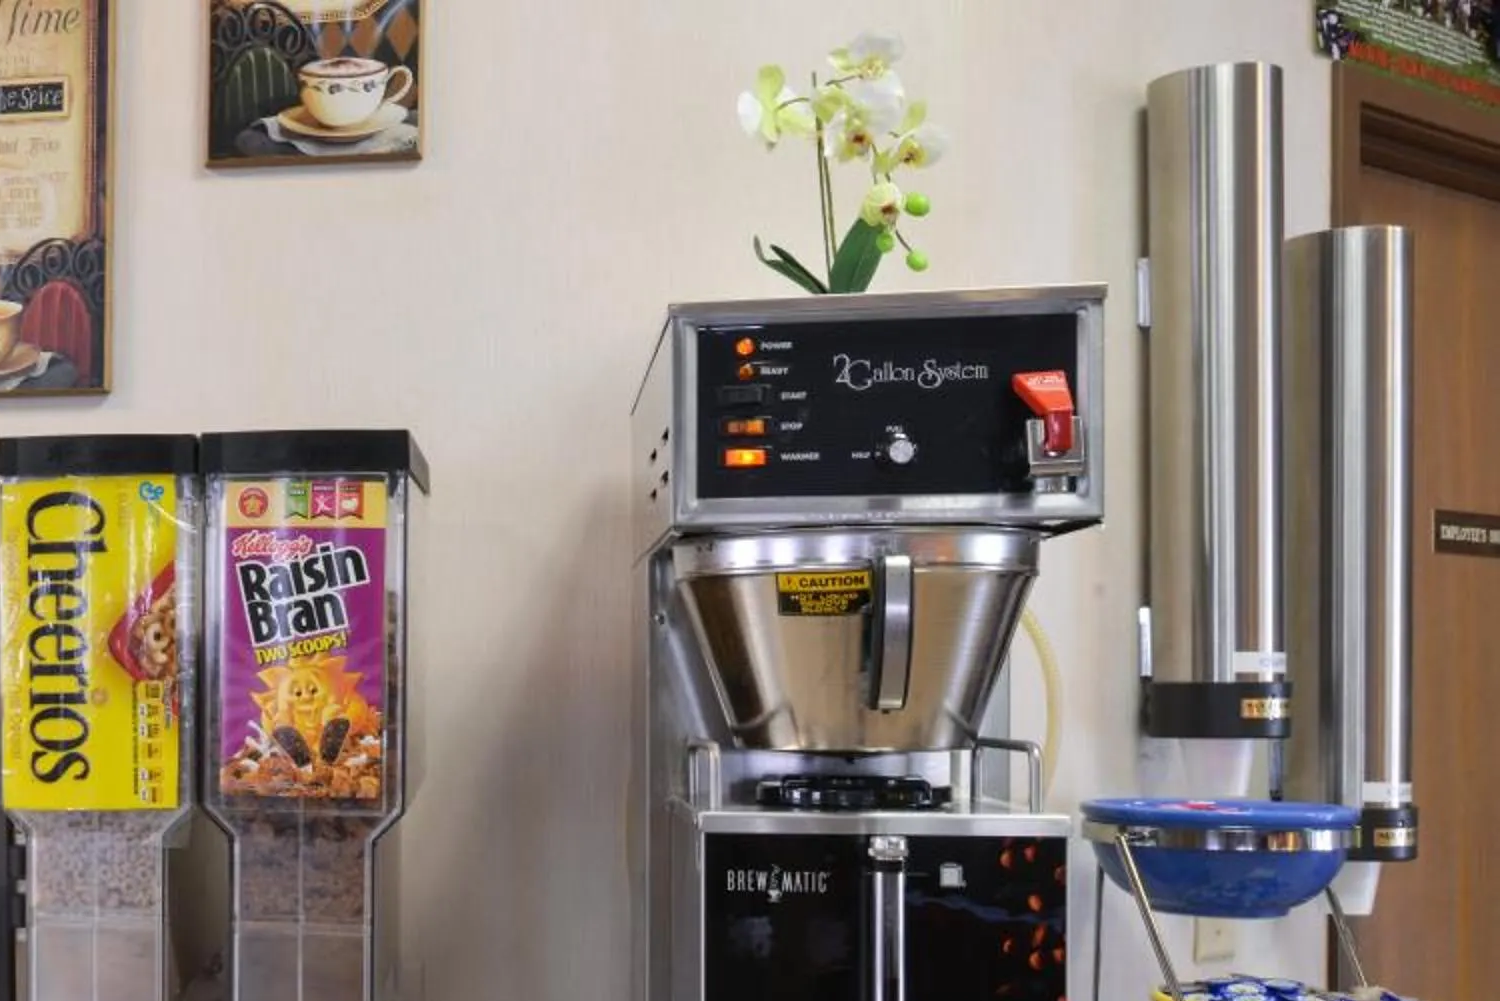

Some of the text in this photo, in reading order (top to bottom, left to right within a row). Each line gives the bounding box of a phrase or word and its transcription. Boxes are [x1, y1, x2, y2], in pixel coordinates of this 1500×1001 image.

[5, 0, 81, 44] Time
[18, 85, 63, 110] Spice
[760, 341, 793, 351] POWER
[917, 358, 989, 389] System
[780, 422, 803, 431] STOP
[780, 452, 819, 461] WARMER
[236, 542, 371, 602] Raisin
[799, 576, 865, 588] CAUTION
[245, 592, 349, 647] Bran
[26, 490, 108, 785] Cheerios
[254, 629, 348, 665] TWO SCOOPS!
[726, 869, 768, 892] BREW
